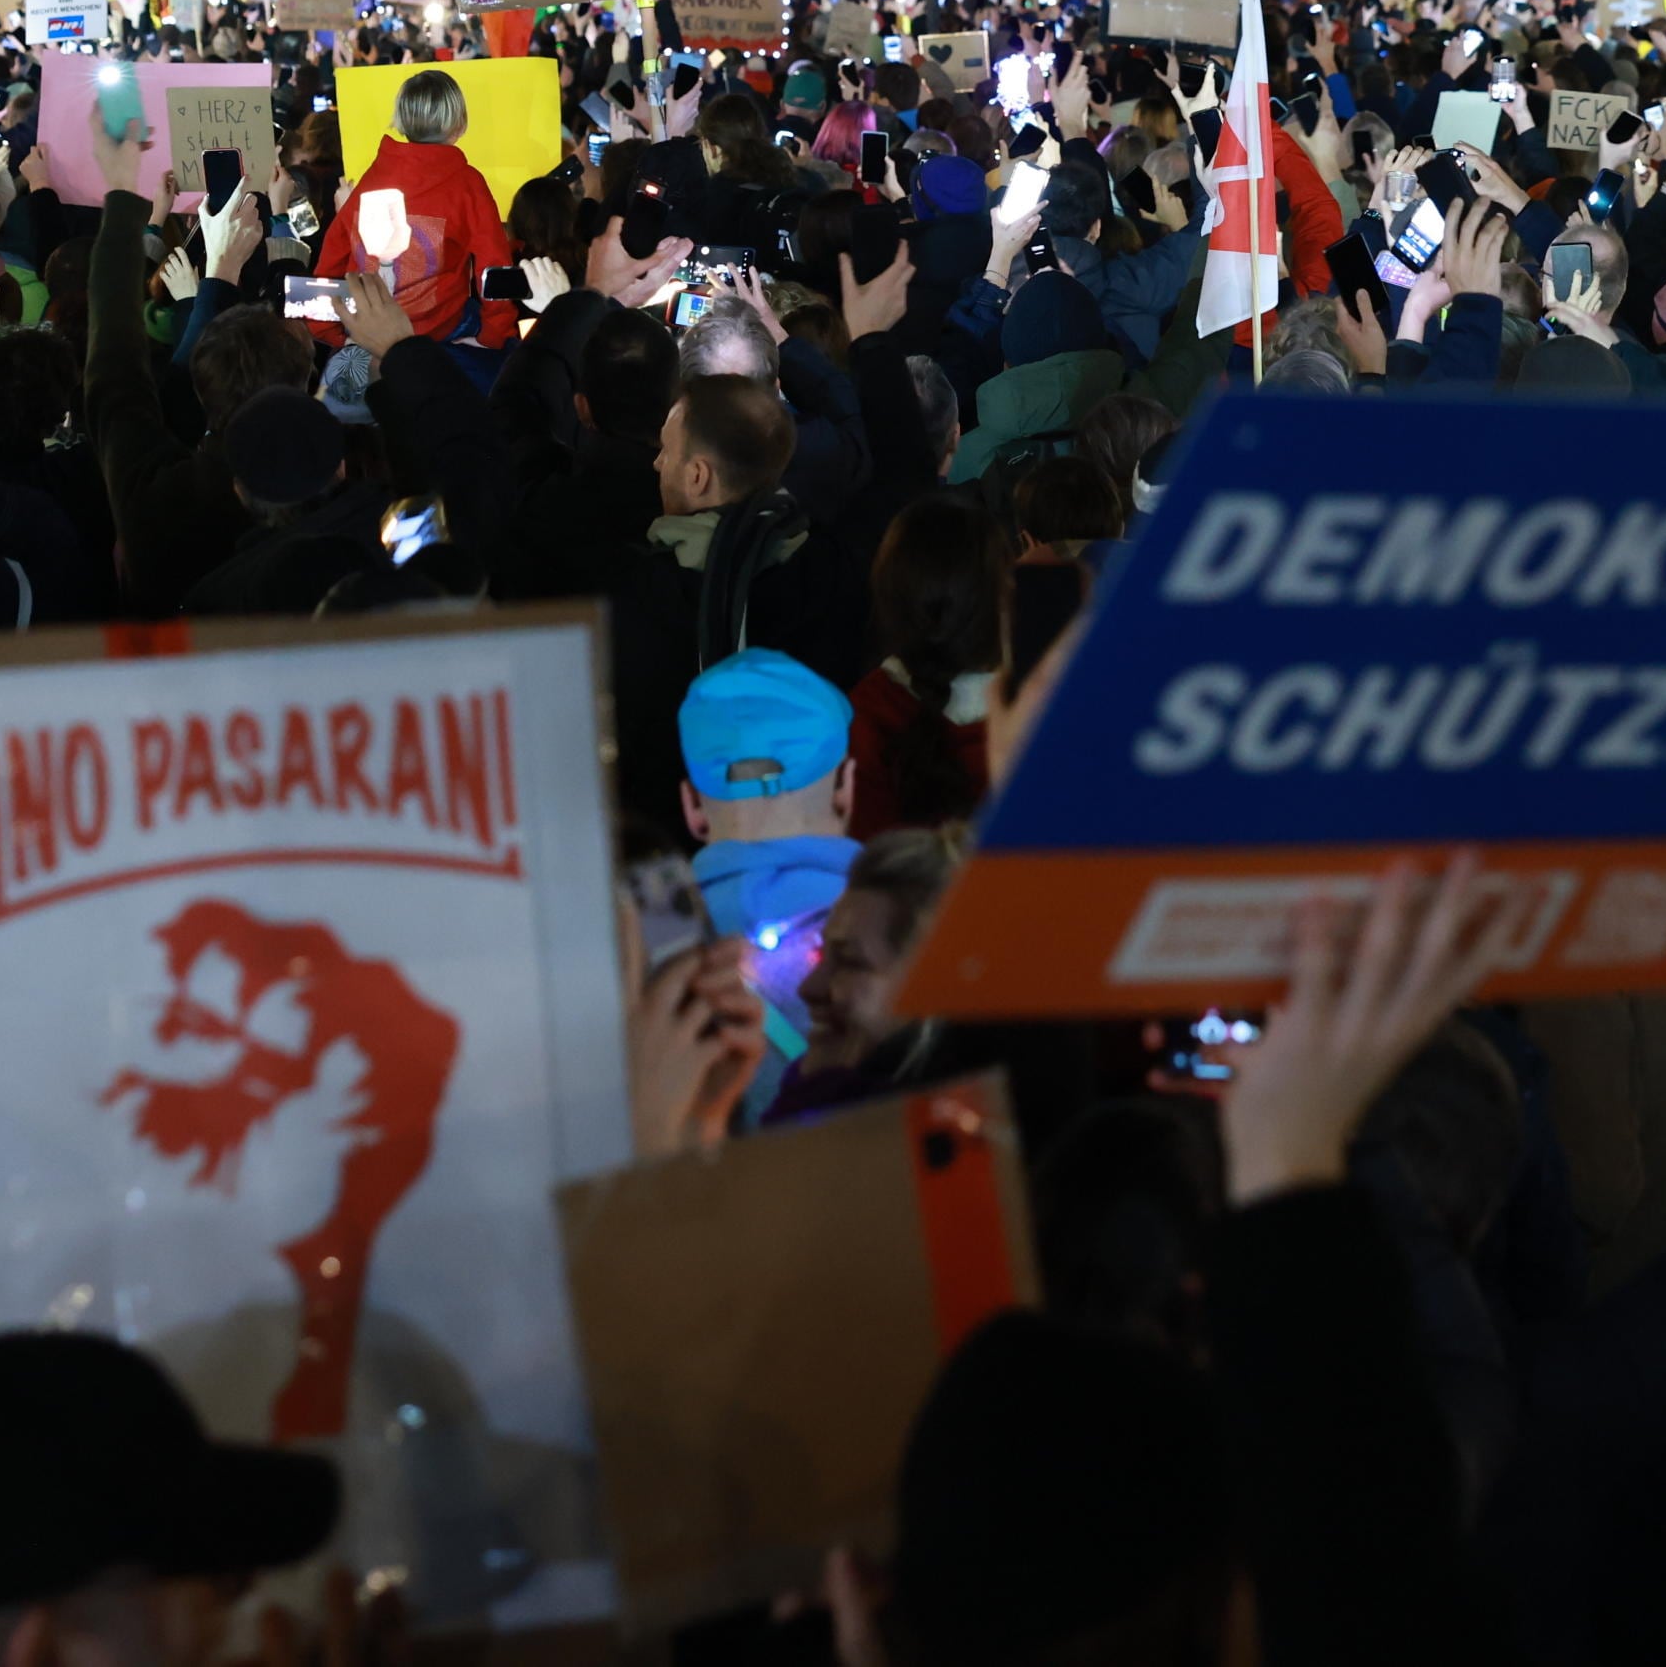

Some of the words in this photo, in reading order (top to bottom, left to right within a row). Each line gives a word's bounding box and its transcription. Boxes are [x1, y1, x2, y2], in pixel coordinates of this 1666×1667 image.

[198, 99, 246, 124] HERZ
[1558, 96, 1612, 124] FCK
[186, 130, 253, 151] statt
[1553, 124, 1600, 147] NAZ
[130, 689, 520, 851] PASARAN!
